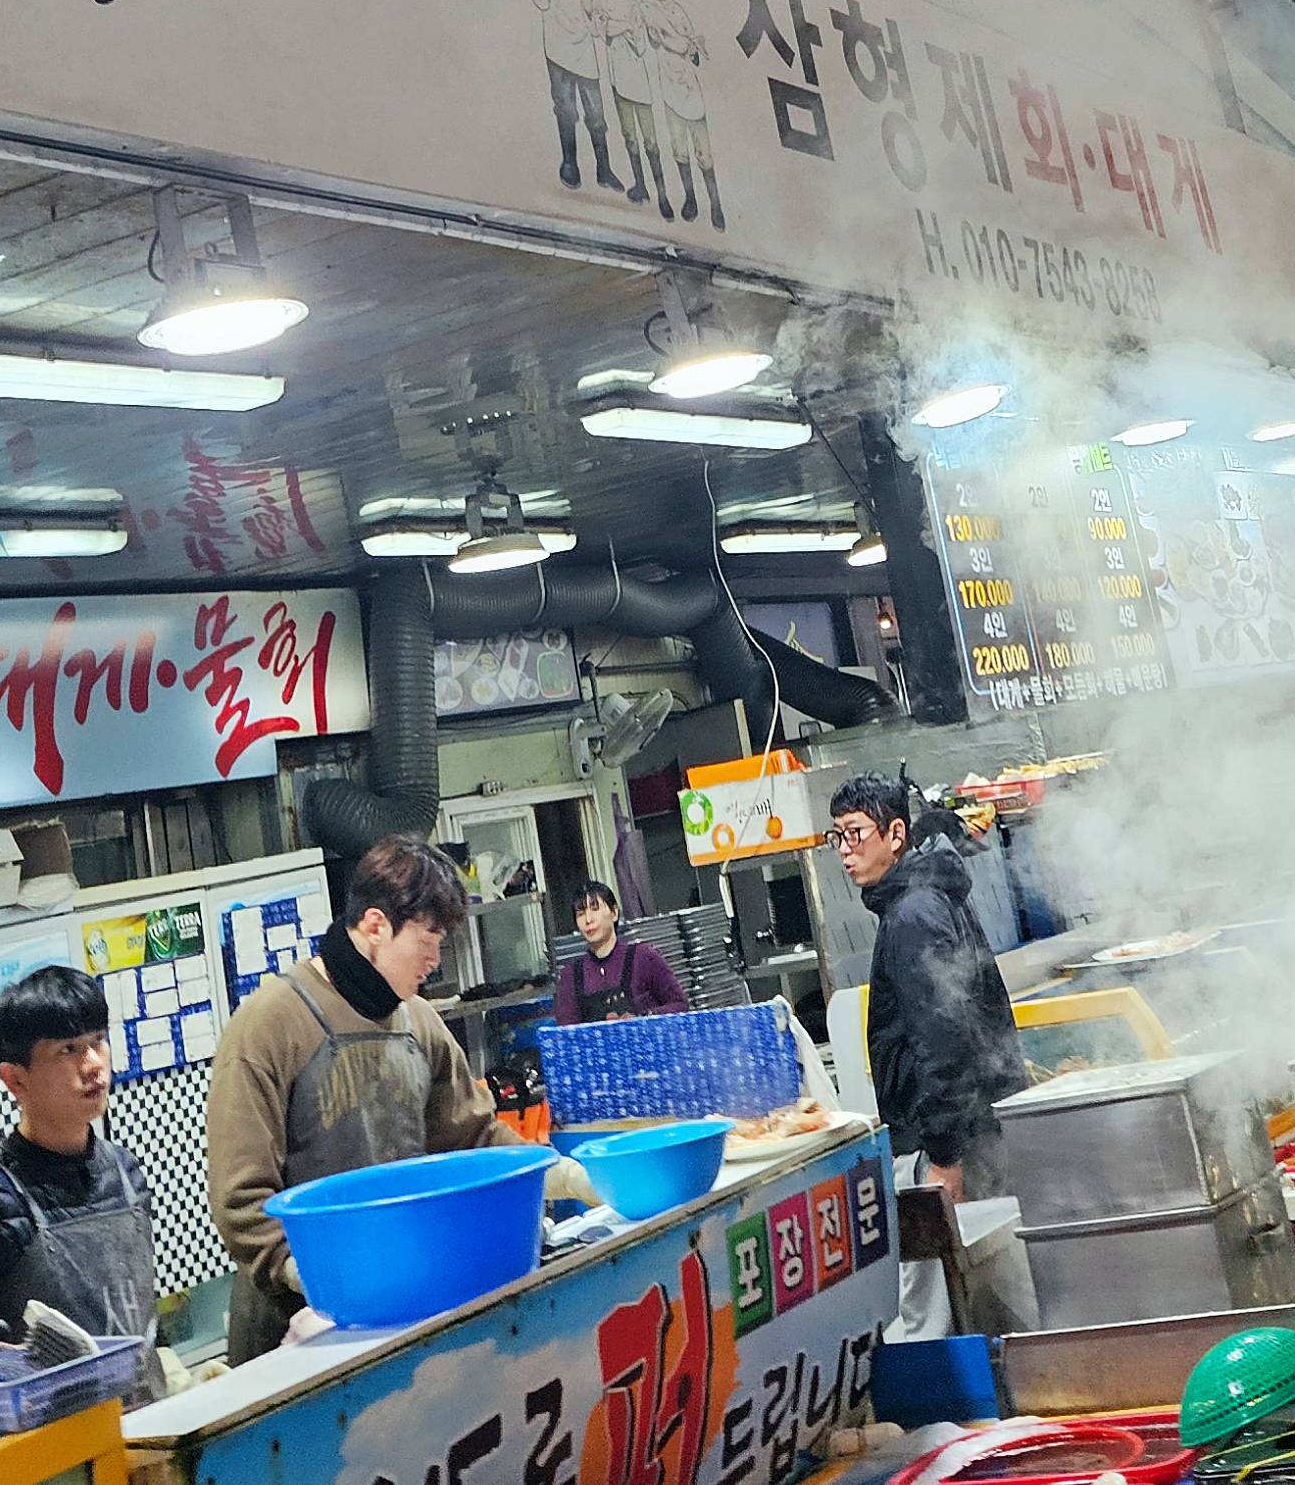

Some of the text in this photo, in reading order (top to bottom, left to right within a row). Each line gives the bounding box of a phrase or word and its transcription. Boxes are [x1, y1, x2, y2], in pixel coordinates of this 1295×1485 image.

[1091, 488, 1113, 512] 2인
[1087, 517, 1127, 540] 90.000
[969, 547, 993, 574] 3인
[1104, 546, 1125, 570] 3인
[958, 578, 1014, 609] 170.000
[1098, 574, 1142, 599] 120.000
[983, 611, 1008, 639] 4인
[1055, 608, 1077, 633] 4인
[1118, 604, 1138, 628] 4인
[972, 643, 1030, 676] 220.000
[1045, 640, 1096, 669] 180.000
[735, 1176, 880, 1309] 포장전문
